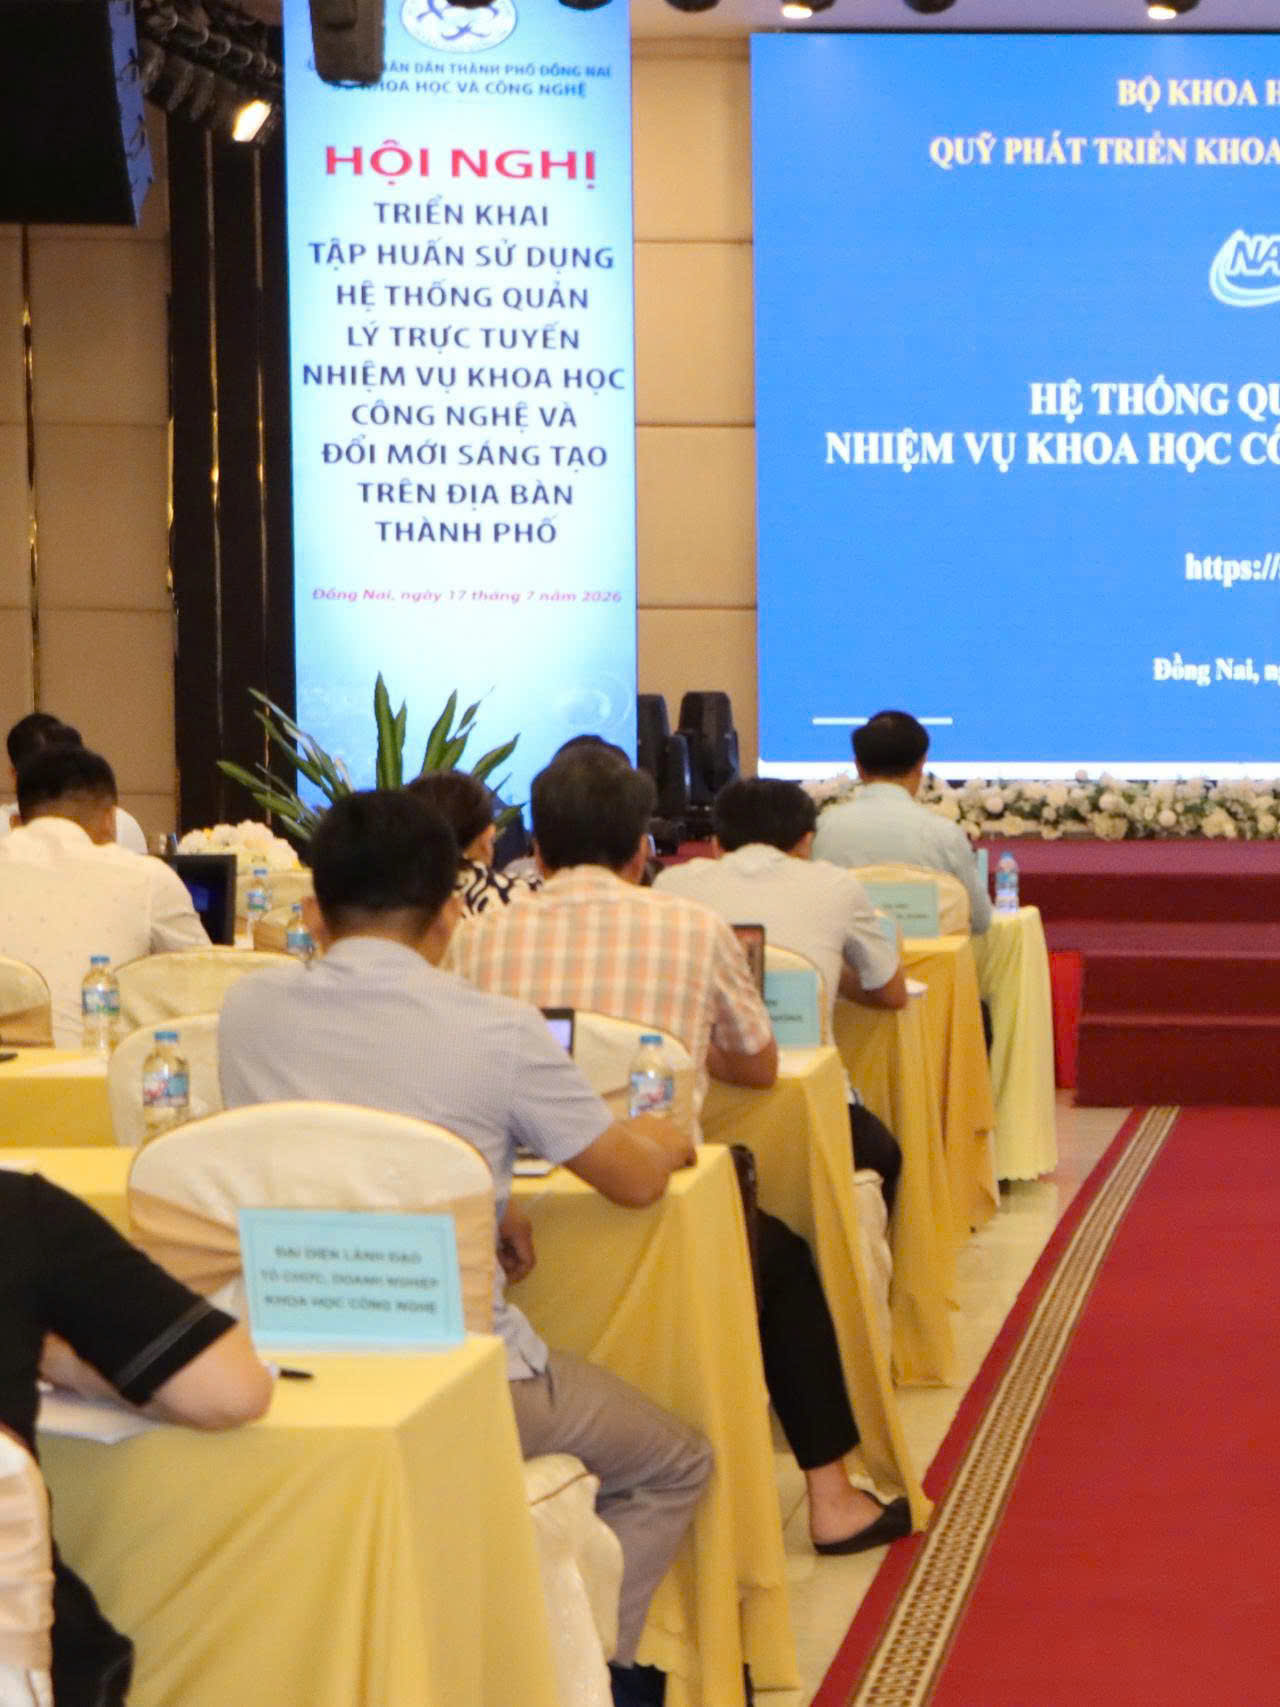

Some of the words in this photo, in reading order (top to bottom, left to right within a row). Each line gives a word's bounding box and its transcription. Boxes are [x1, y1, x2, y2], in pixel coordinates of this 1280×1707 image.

[485, 79, 532, 95] CÔNG
[1118, 75, 1161, 113] BỘ
[1168, 79, 1258, 106] KHOA
[326, 139, 429, 185] HỘI
[451, 148, 596, 189] NGHỊ
[929, 130, 996, 170] QUỸ
[1004, 129, 1087, 165] PHÁT
[1092, 130, 1188, 165] TRIỂN
[374, 194, 464, 225] TRIỂN
[476, 205, 548, 226] KHAI
[309, 238, 366, 270] TẬP
[377, 238, 464, 266] HUẤN
[476, 239, 517, 267] SỬ
[527, 247, 614, 274] DỤNG
[337, 280, 375, 311] HỆ
[385, 279, 492, 308] THỐNG
[503, 281, 589, 309] QUẢN
[347, 321, 379, 346] LÝ
[390, 325, 470, 354] TRỰC
[480, 321, 579, 349] TUYẾN
[303, 361, 405, 392] NHIỆM
[416, 367, 456, 394] VỤ
[468, 367, 552, 389] KHOA
[563, 368, 625, 395] HỌC
[352, 399, 435, 426] CÔNG
[446, 401, 528, 433] NGHỆ
[539, 402, 577, 428] VÀ
[1030, 378, 1083, 424] HỆ
[1090, 374, 1230, 416] THỐNG
[322, 434, 375, 465] ĐỔI
[387, 439, 446, 465] MỚI
[458, 440, 541, 467] SÁNG
[550, 446, 607, 473] TẠO
[825, 427, 955, 473] NHIỆM
[963, 432, 1017, 473] VỤ
[1027, 432, 1139, 465] KHOA
[1148, 432, 1232, 473] HỌC
[358, 478, 435, 504] TRÊN
[447, 483, 499, 511] ĐỊA
[511, 480, 573, 506] BÀN
[375, 516, 481, 543] THÀNH
[494, 516, 557, 544] PHỐ
[1153, 652, 1211, 687] Đồng
[1216, 658, 1259, 685] Nai,
